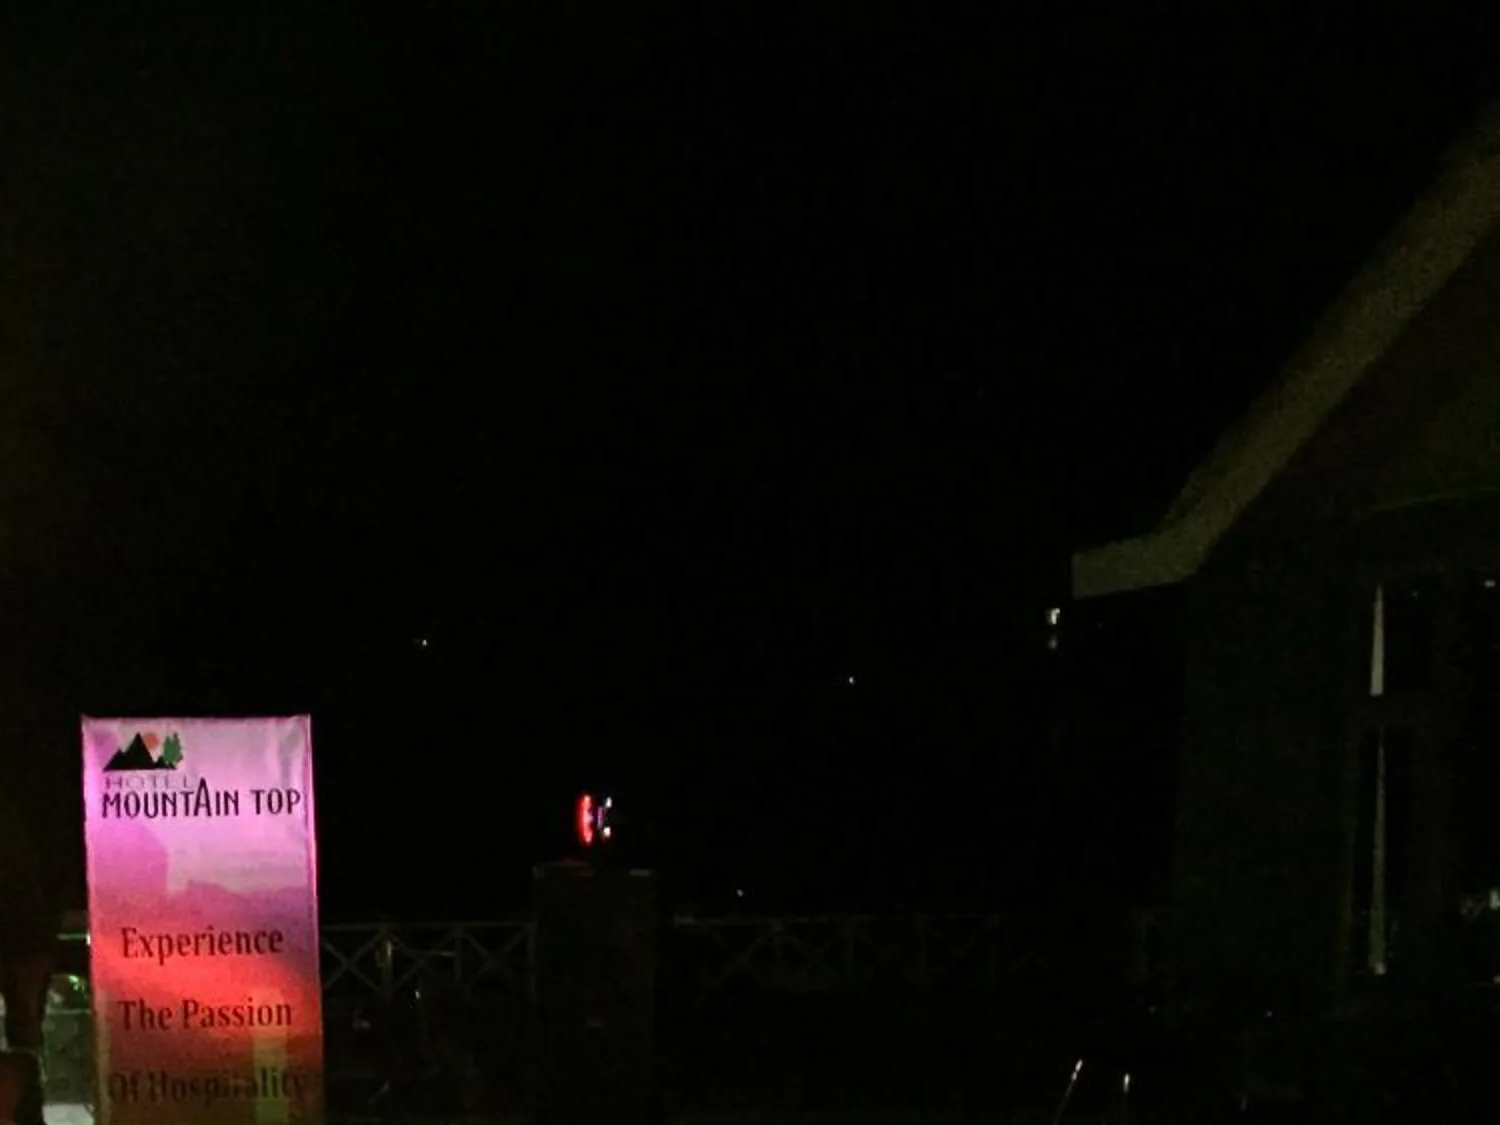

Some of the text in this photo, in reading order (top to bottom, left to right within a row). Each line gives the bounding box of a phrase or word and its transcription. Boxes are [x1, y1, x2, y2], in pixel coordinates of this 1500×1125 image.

[251, 788, 301, 815] TOP
[120, 925, 285, 965] Experience
[118, 997, 292, 1031] The Passion
